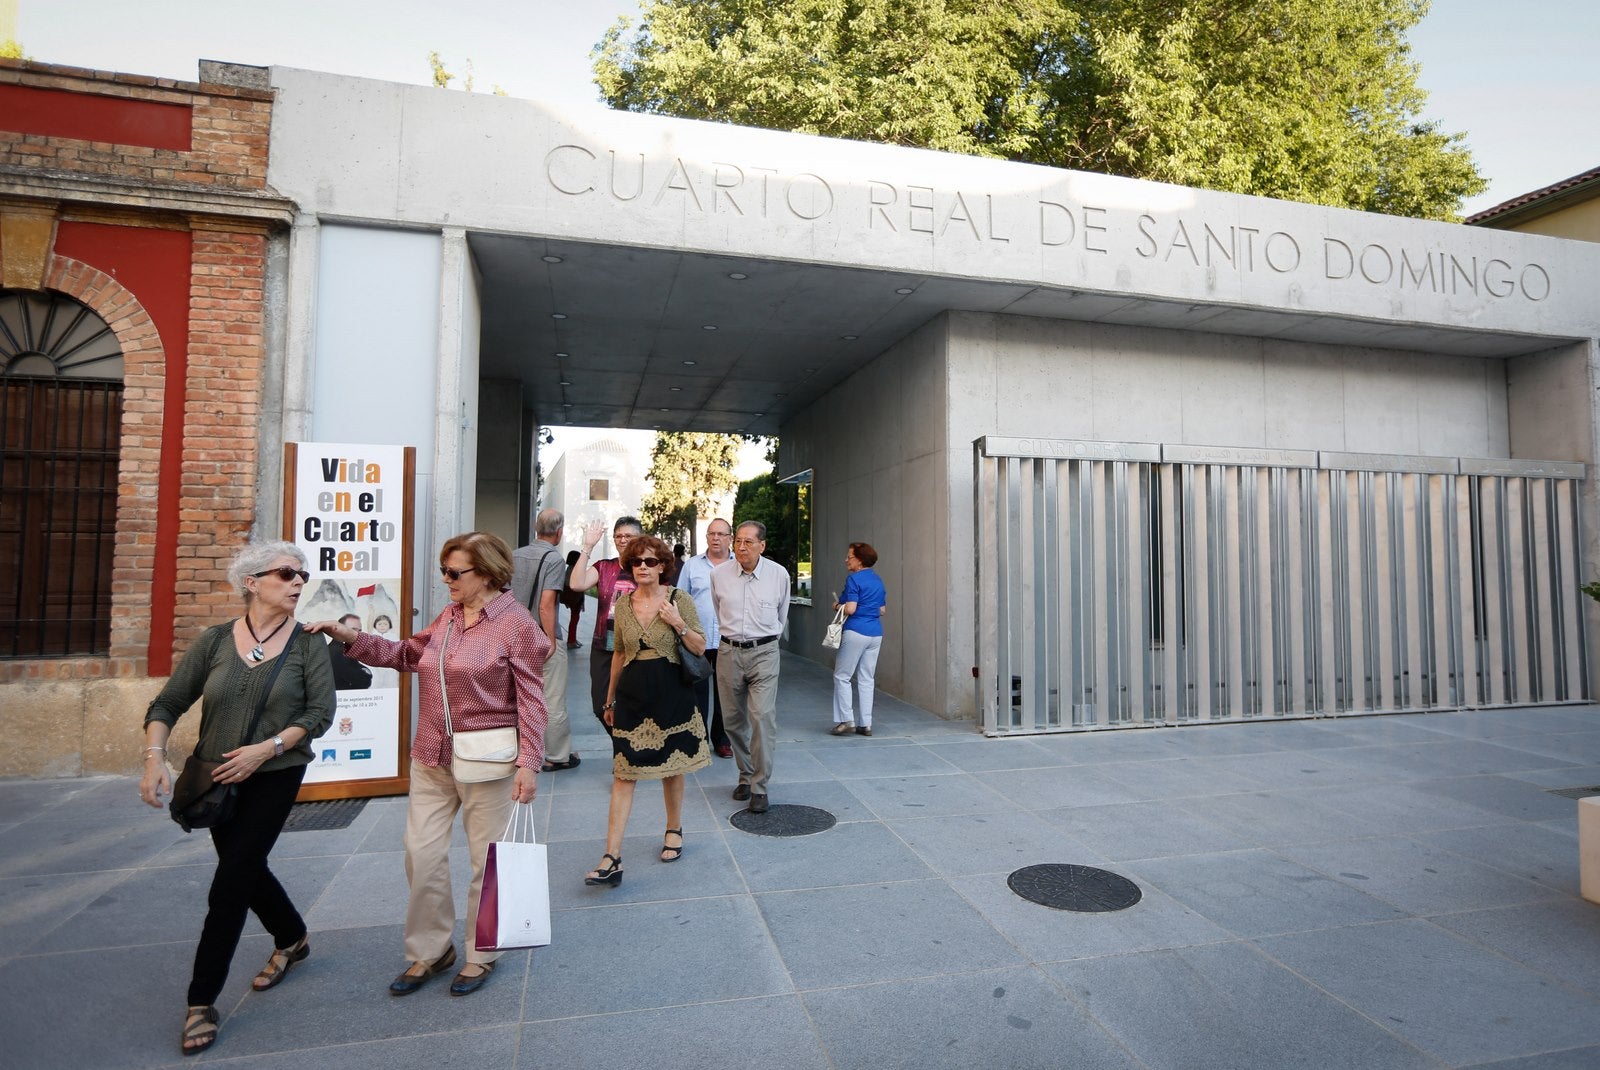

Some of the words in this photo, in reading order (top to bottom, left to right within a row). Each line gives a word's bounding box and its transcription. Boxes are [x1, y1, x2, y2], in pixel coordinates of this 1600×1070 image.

[545, 144, 835, 221] CUARTO
[868, 180, 1010, 243] REAL
[1039, 200, 1108, 255] DE
[1135, 213, 1301, 274] SANTO
[1323, 236, 1551, 301] DOMINGO
[1018, 439, 1088, 456] CUARTO
[1093, 443, 1131, 458] REAL
[321, 458, 381, 483] Vida
[317, 491, 351, 512] en
[358, 489, 383, 512] el
[304, 516, 395, 542] Cuarto
[319, 547, 379, 571] Real
